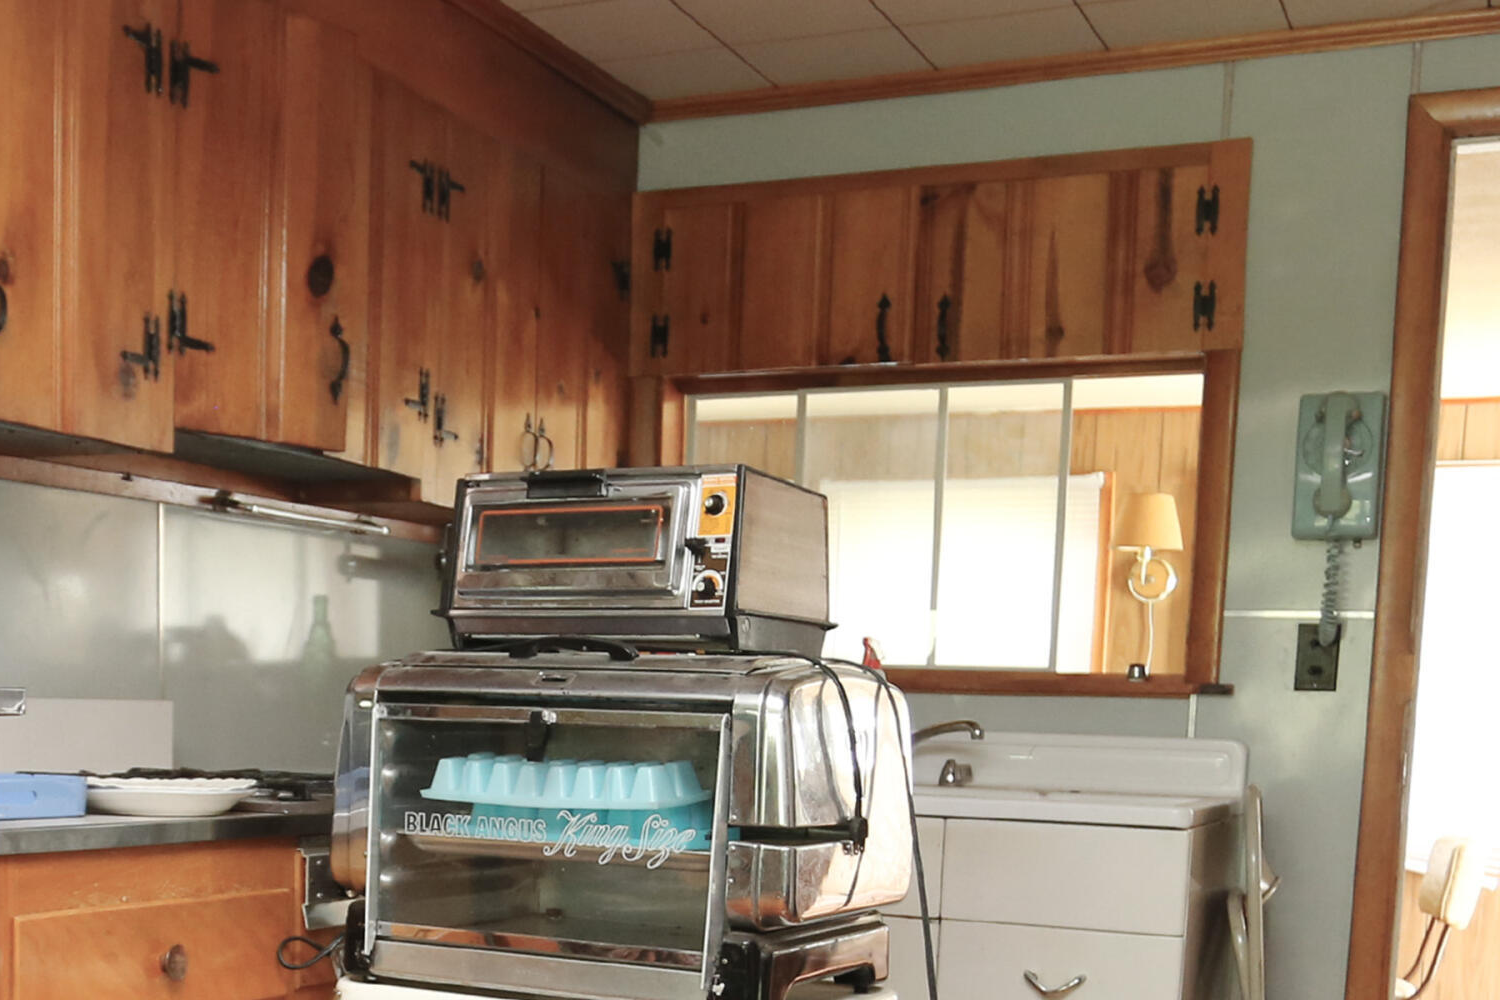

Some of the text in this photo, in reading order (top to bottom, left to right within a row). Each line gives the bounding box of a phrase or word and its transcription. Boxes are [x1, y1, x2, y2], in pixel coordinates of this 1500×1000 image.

[404, 810, 697, 869] BLACK ANGUS King Size
